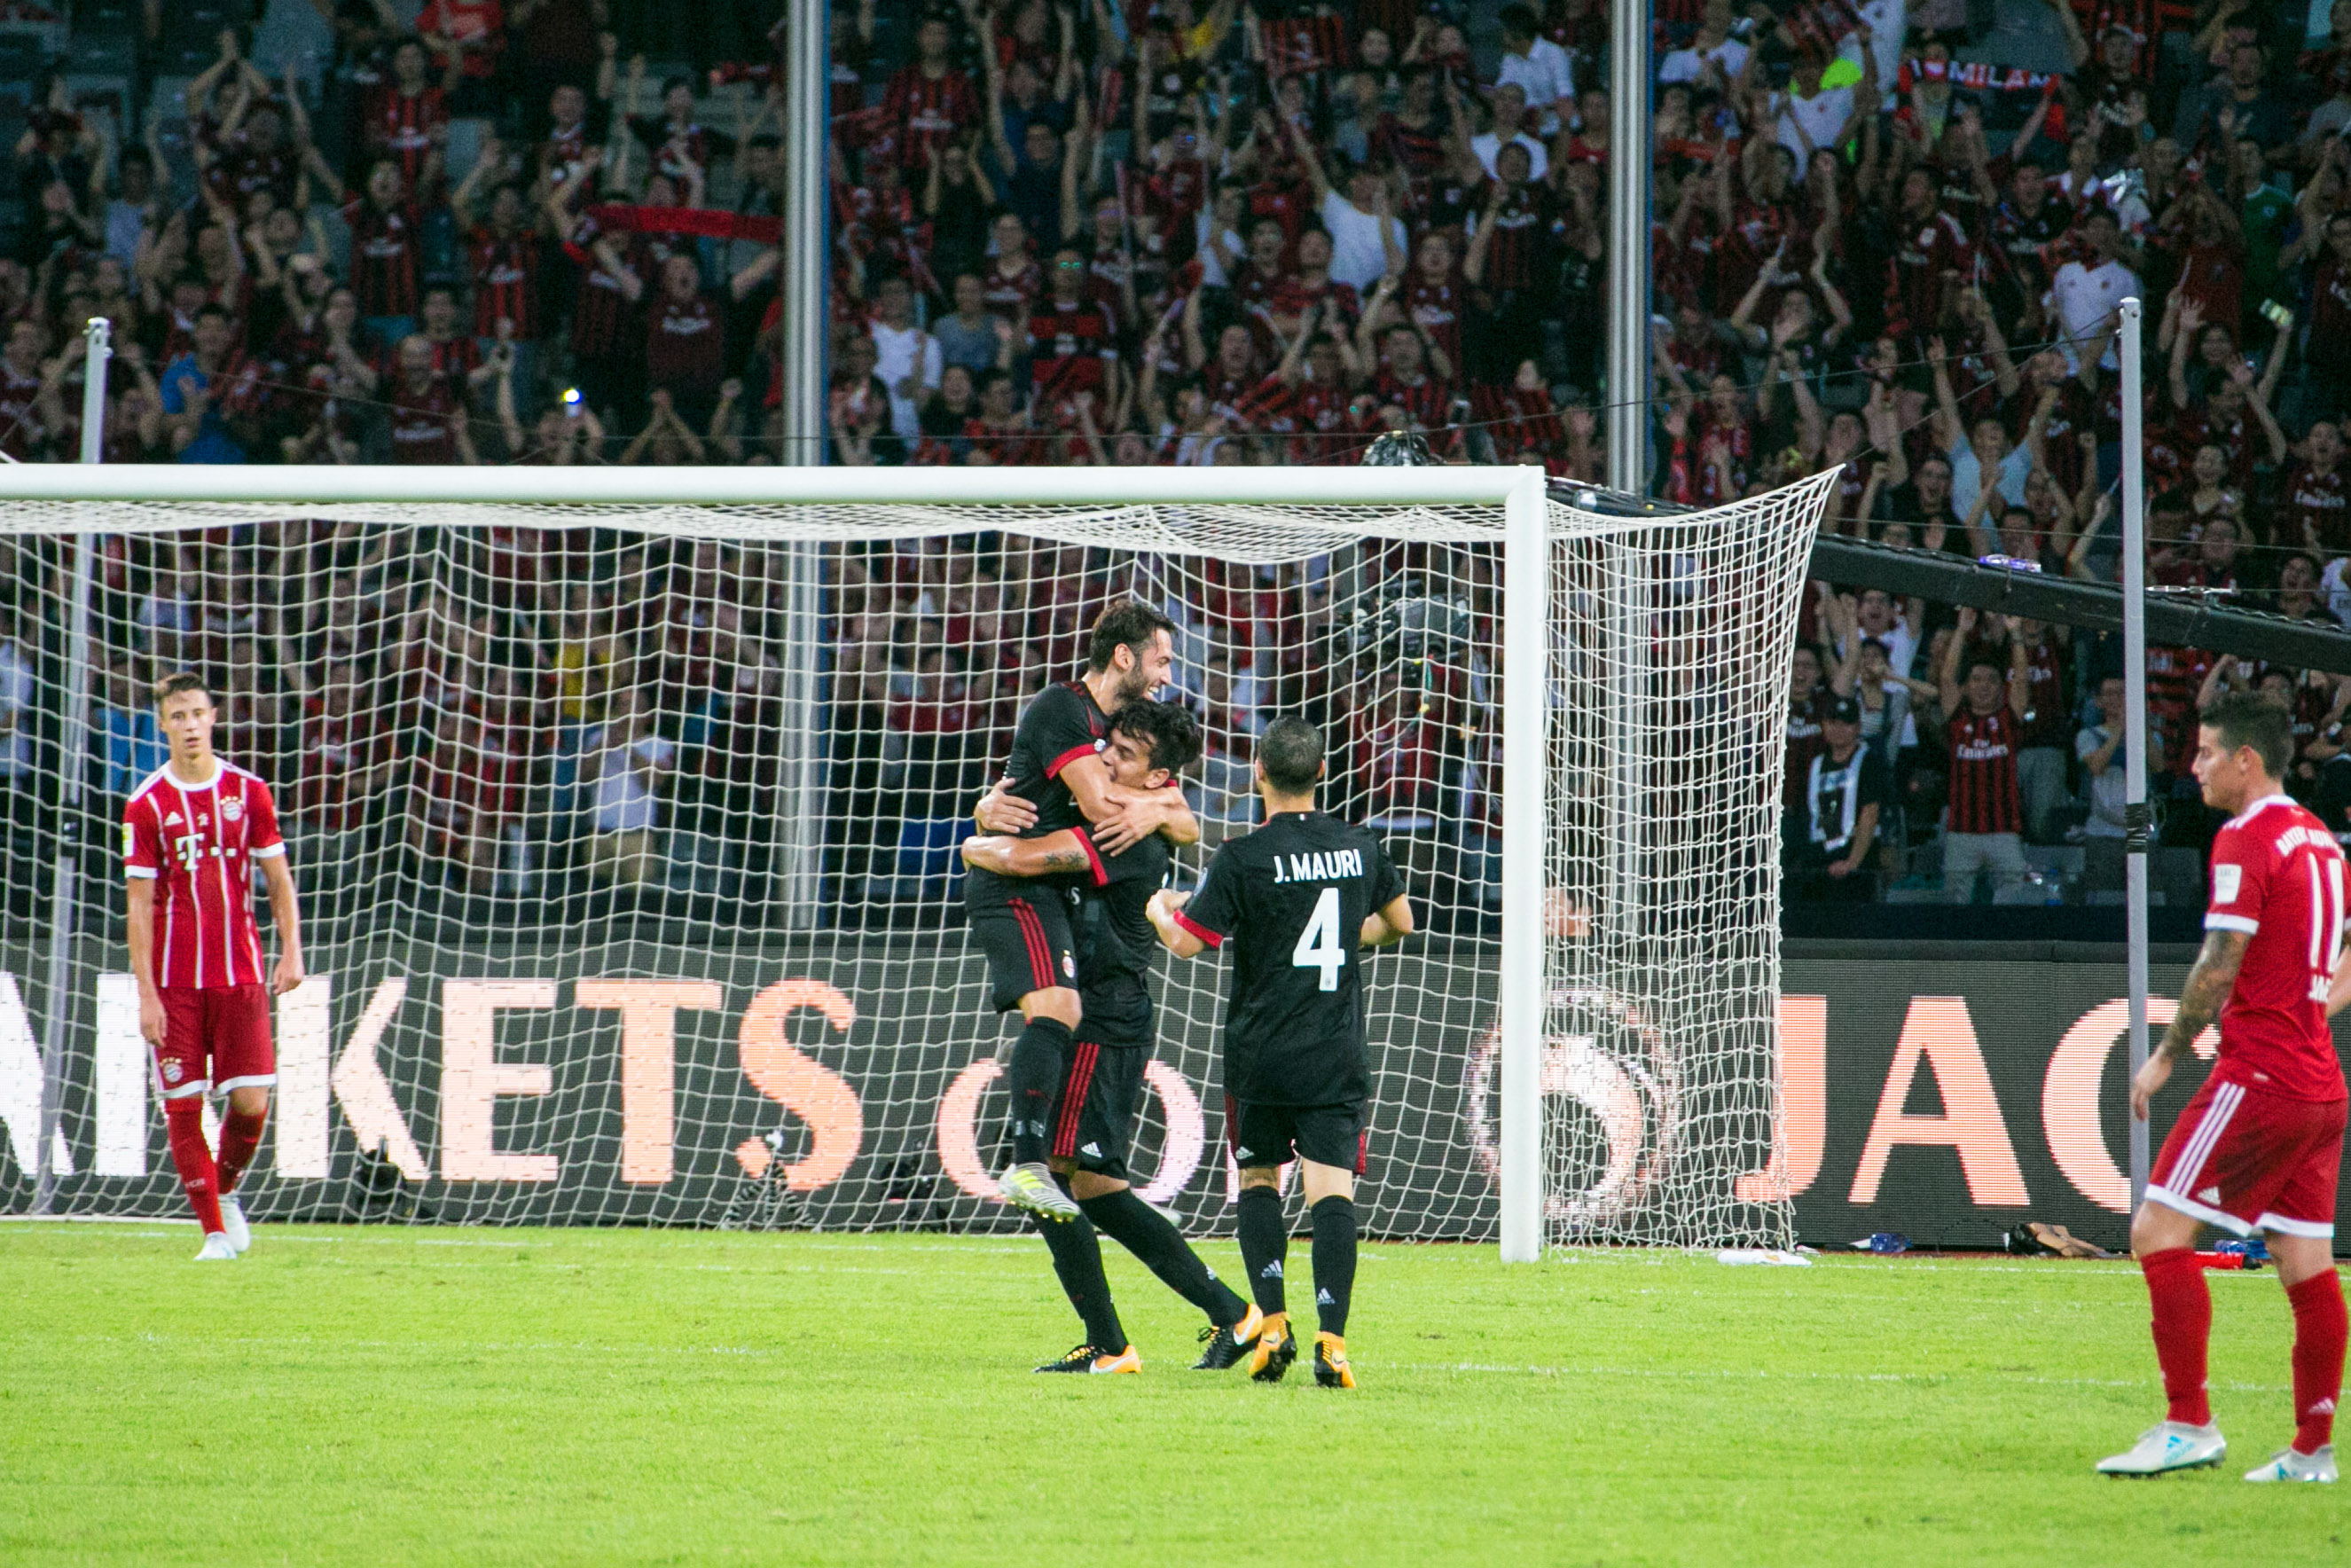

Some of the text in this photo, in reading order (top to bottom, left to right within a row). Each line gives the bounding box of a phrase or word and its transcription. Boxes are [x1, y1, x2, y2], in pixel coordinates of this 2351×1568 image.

[1947, 60, 2050, 89] MILAN
[1273, 849, 1363, 883] J.MAURI
[1293, 887, 1345, 992] 4
[2308, 851, 2345, 974] 11
